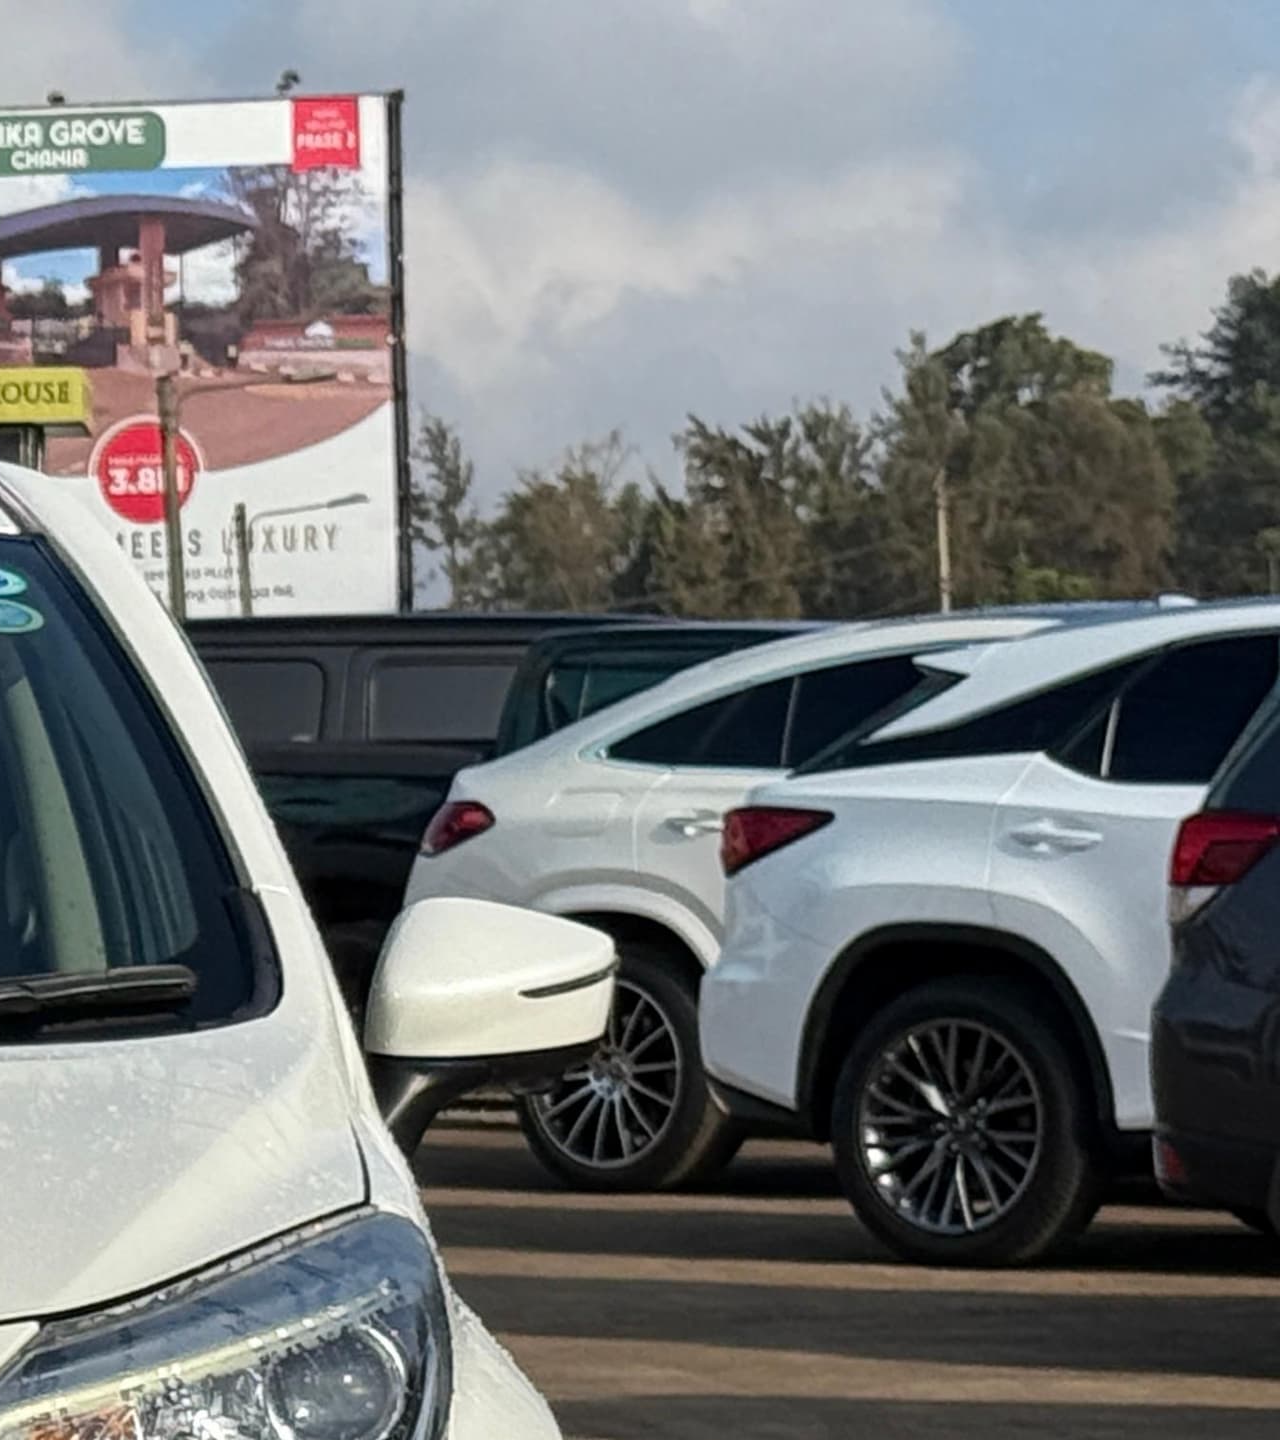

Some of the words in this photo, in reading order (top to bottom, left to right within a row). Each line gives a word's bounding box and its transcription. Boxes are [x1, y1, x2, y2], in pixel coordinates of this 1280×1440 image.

[49, 117, 146, 148] GROVE
[10, 148, 88, 171] CHANIA
[116, 528, 203, 560] EES
